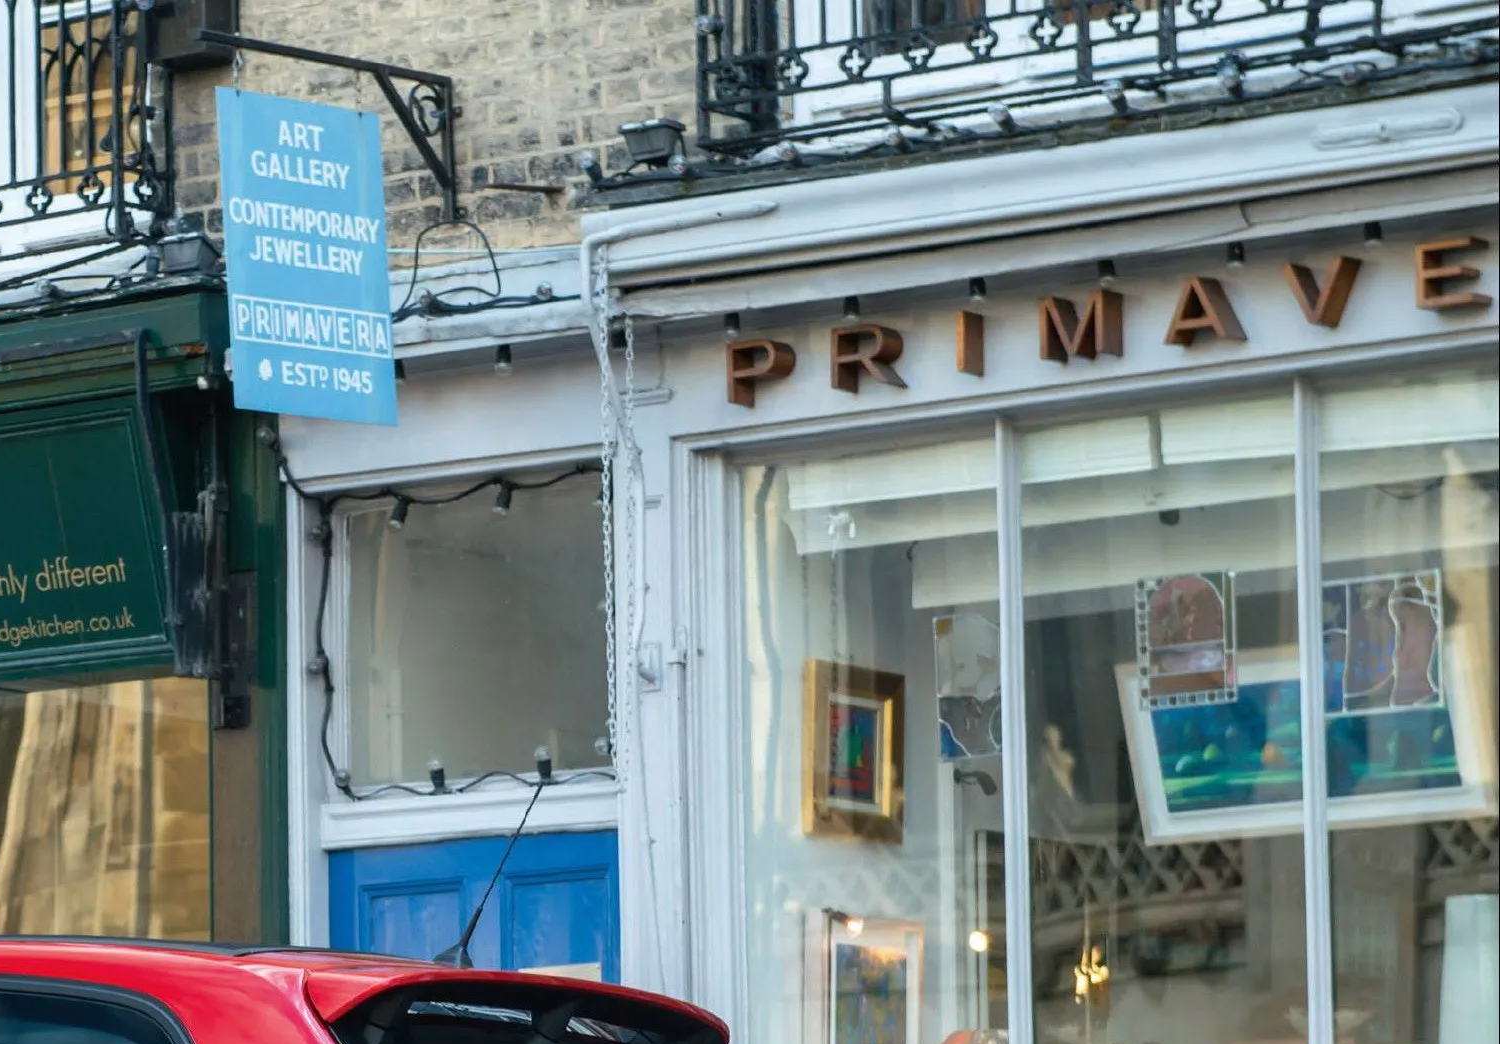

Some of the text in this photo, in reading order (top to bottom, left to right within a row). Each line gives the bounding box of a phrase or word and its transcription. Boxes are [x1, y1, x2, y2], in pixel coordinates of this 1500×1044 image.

[278, 120, 324, 152] ART
[250, 150, 350, 190] GALLERY
[229, 197, 380, 244] CONTEMPORARY
[250, 236, 363, 276] JEWELLERY
[238, 302, 389, 350] PRIMAVERA
[726, 235, 1493, 409] PRIMAVE
[333, 369, 373, 394] 1945
[36, 556, 126, 592] different
